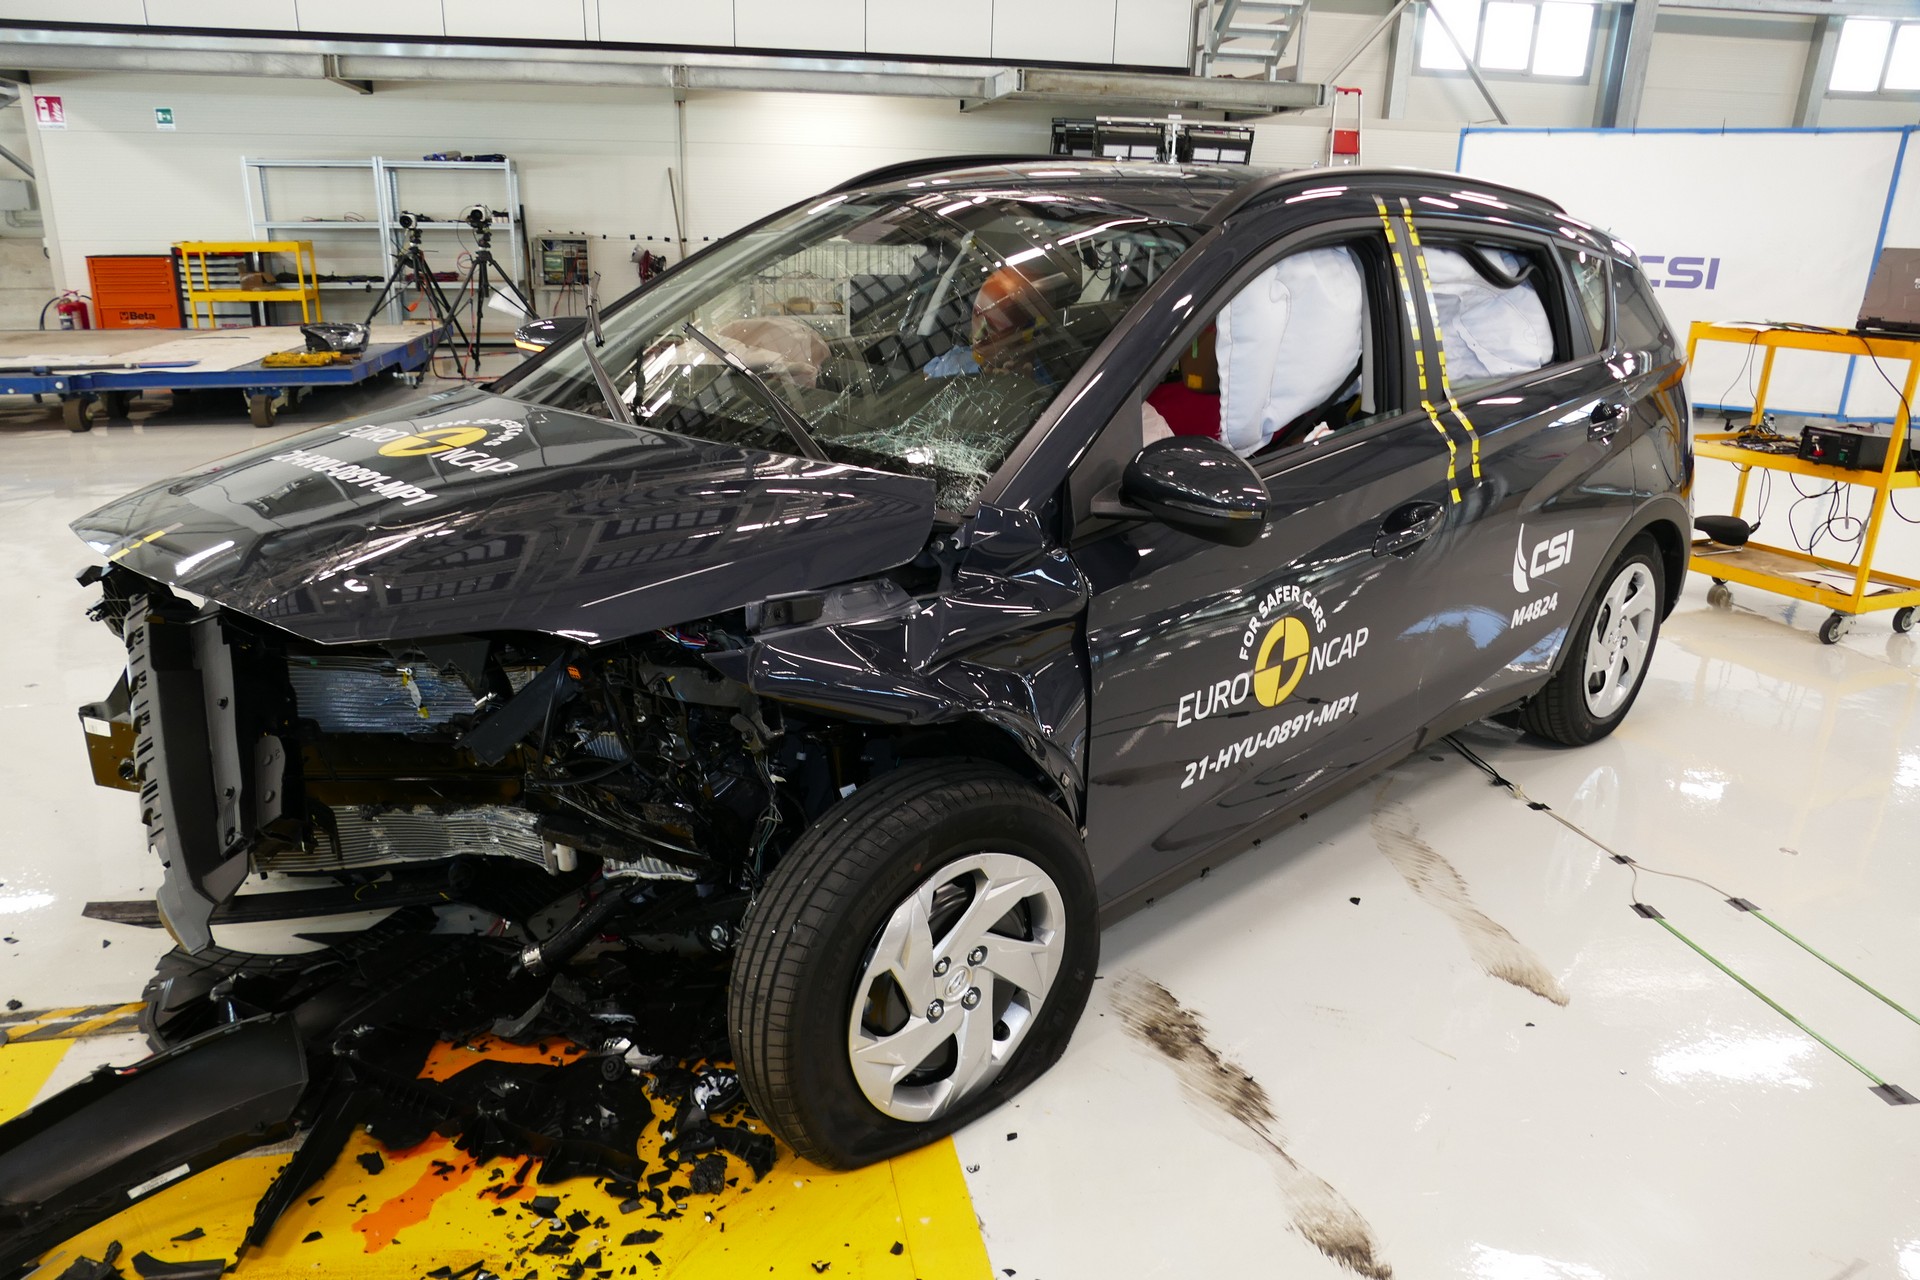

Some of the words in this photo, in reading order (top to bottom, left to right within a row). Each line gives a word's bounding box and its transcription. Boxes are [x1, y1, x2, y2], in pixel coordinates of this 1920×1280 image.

[129, 311, 156, 320] Beta
[339, 424, 410, 443] EURO
[432, 447, 519, 473] NCAP
[423, 420, 470, 430] FOR
[271, 449, 438, 507] 21-HYU-0891-MP1
[1530, 529, 1574, 578] CSI
[1239, 616, 1262, 661] FOR
[1258, 585, 1301, 619] SAFER
[1302, 590, 1327, 634] CARS
[1510, 592, 1558, 629] M4824
[1176, 672, 1250, 728] EURO
[1309, 627, 1369, 675] NCAP
[1180, 691, 1359, 790] 21-HYU-0891-MP1
